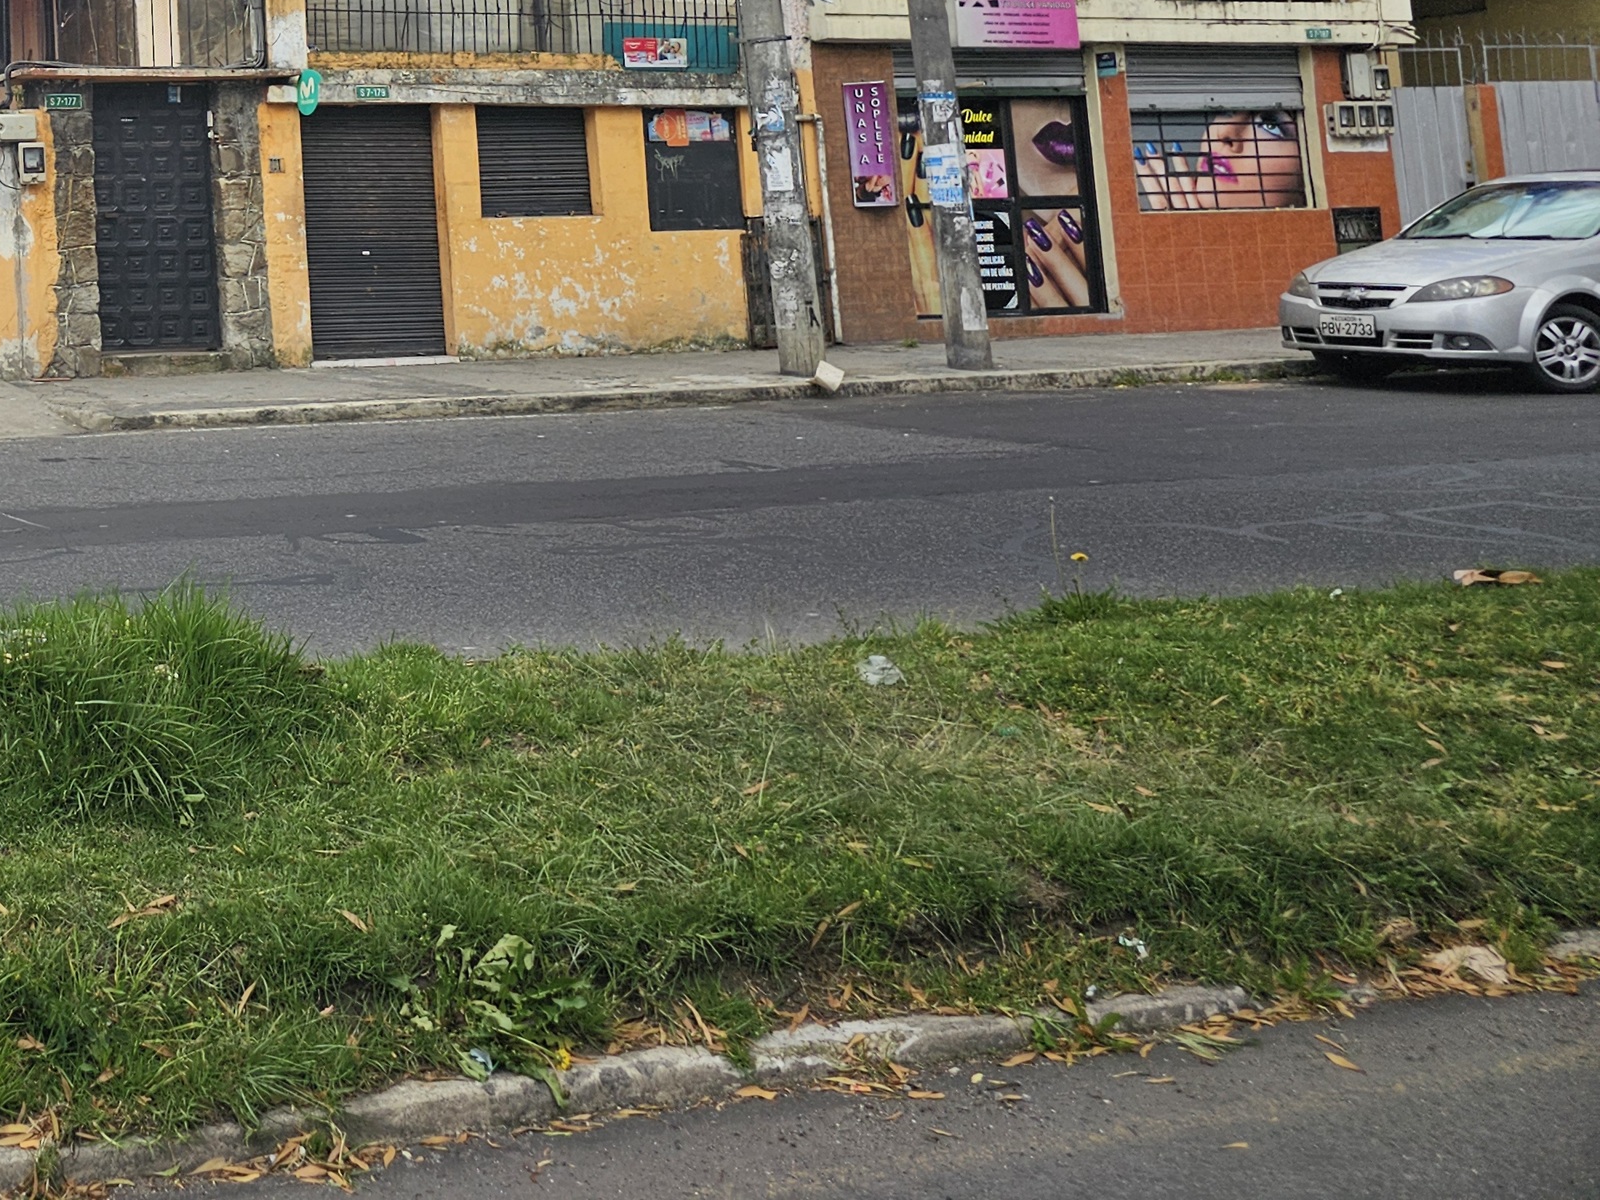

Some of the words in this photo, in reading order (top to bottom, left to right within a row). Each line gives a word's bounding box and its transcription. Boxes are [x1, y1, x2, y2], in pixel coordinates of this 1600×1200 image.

[1038, 1, 1072, 9] VANIDAD
[360, 88, 365, 97] S
[50, 98, 55, 106] S
[57, 97, 77, 106] 7-177
[961, 108, 993, 124] Dulce
[854, 88, 868, 143] UÑAS
[861, 154, 870, 165] A
[870, 87, 885, 164] SOPLETE
[963, 131, 995, 143] nidad
[1321, 322, 1373, 336] PBV-2733
